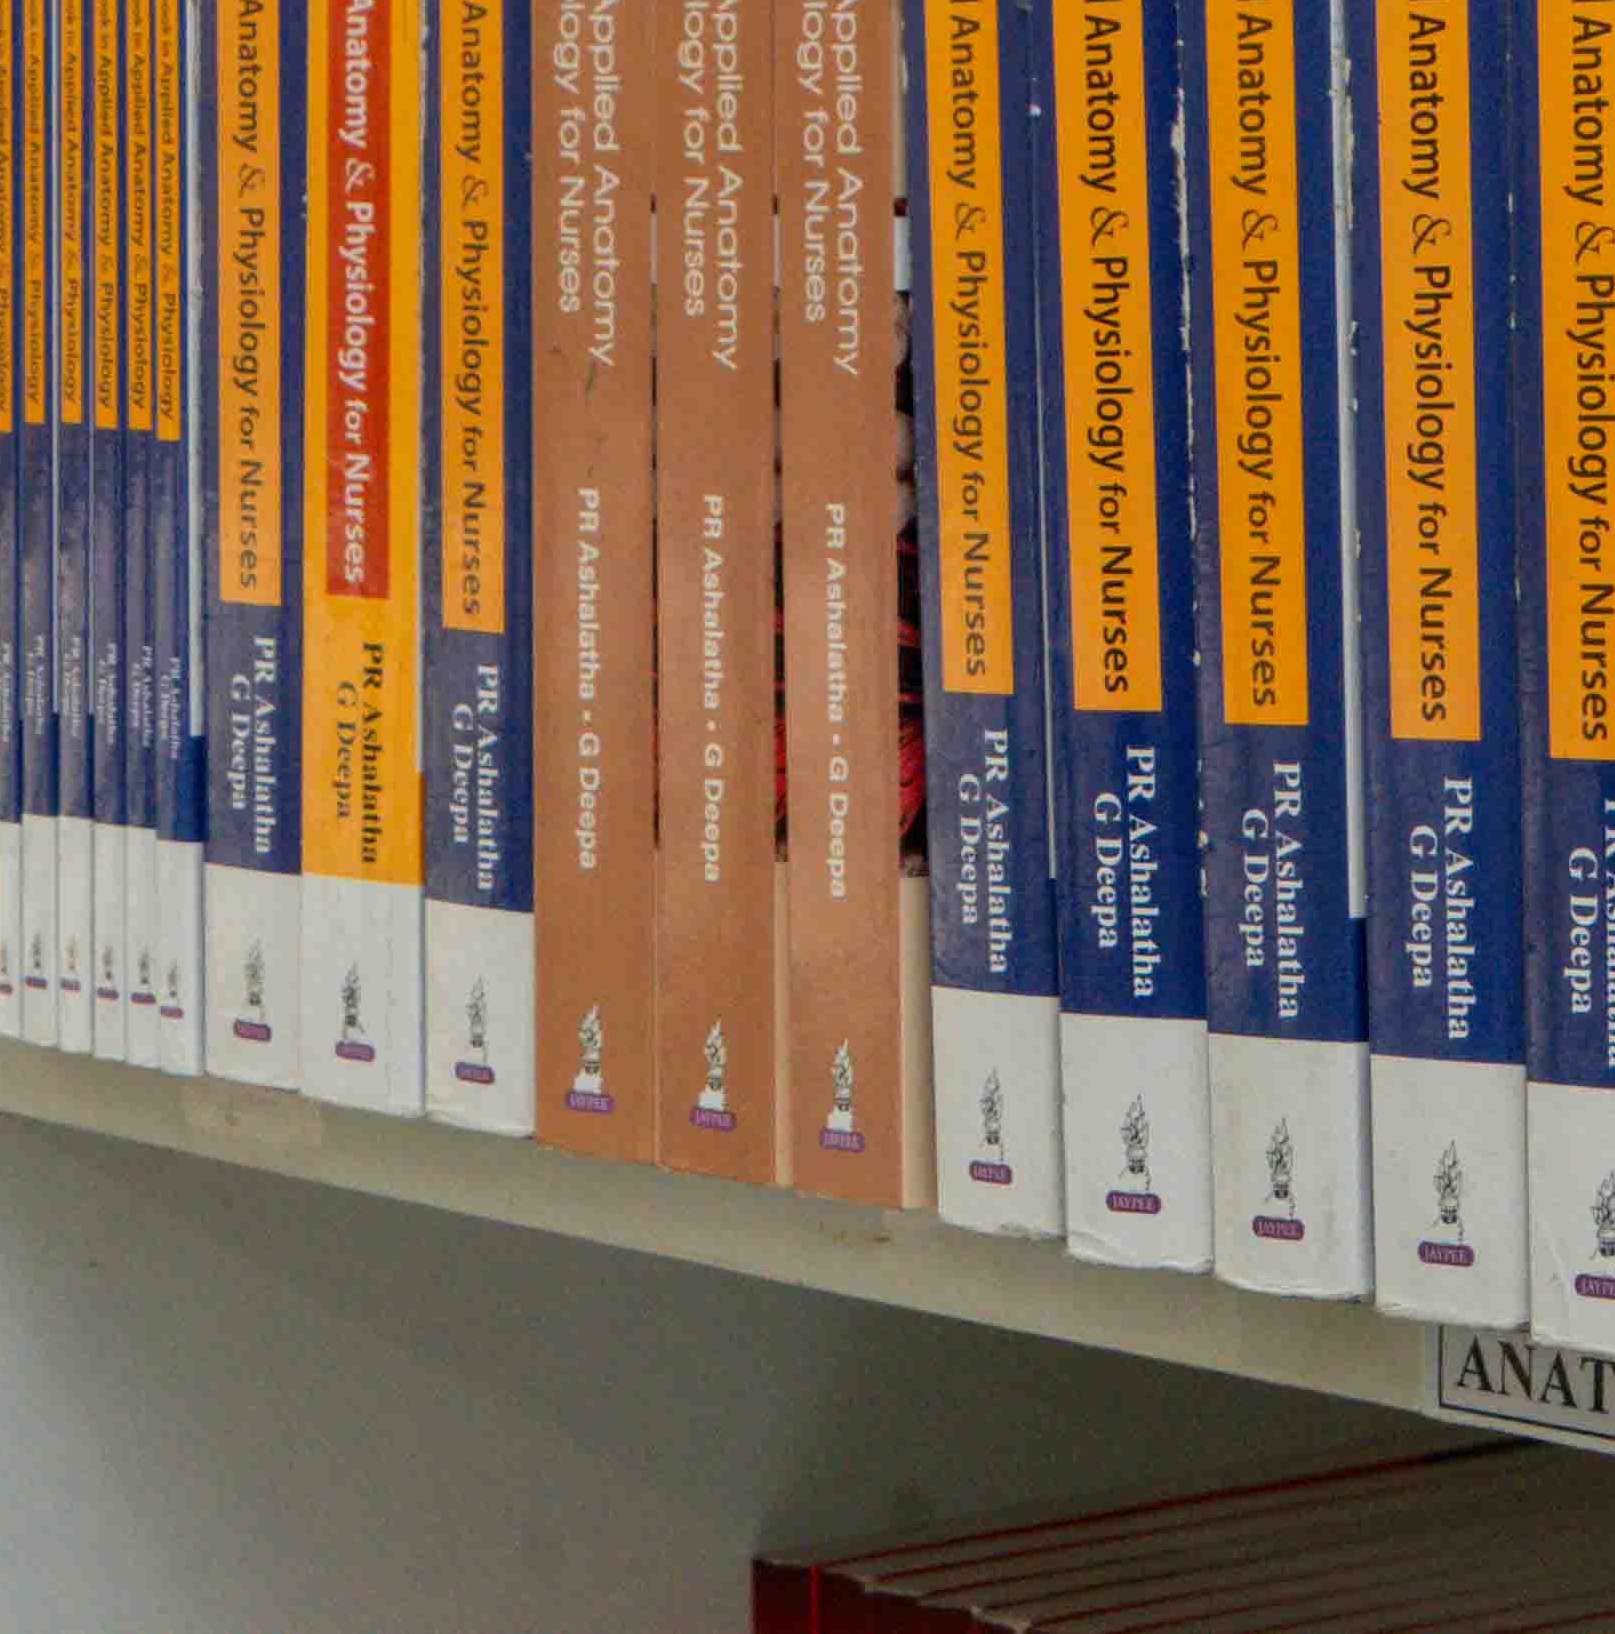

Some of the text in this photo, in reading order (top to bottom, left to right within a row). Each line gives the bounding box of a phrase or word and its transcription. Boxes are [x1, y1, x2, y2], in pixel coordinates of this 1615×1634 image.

[346, 159, 370, 191] &
[684, 107, 710, 164] for
[338, 202, 374, 391] Physiology
[684, 178, 710, 317] Nurses
[711, 166, 744, 370] Anatomy
[345, 400, 367, 444] for
[344, 453, 370, 583] Nurses
[332, 680, 358, 820] G Deepa
[361, 642, 384, 864] PR Ashalatha
[700, 495, 725, 882] PR Ashalatha G Deepa
